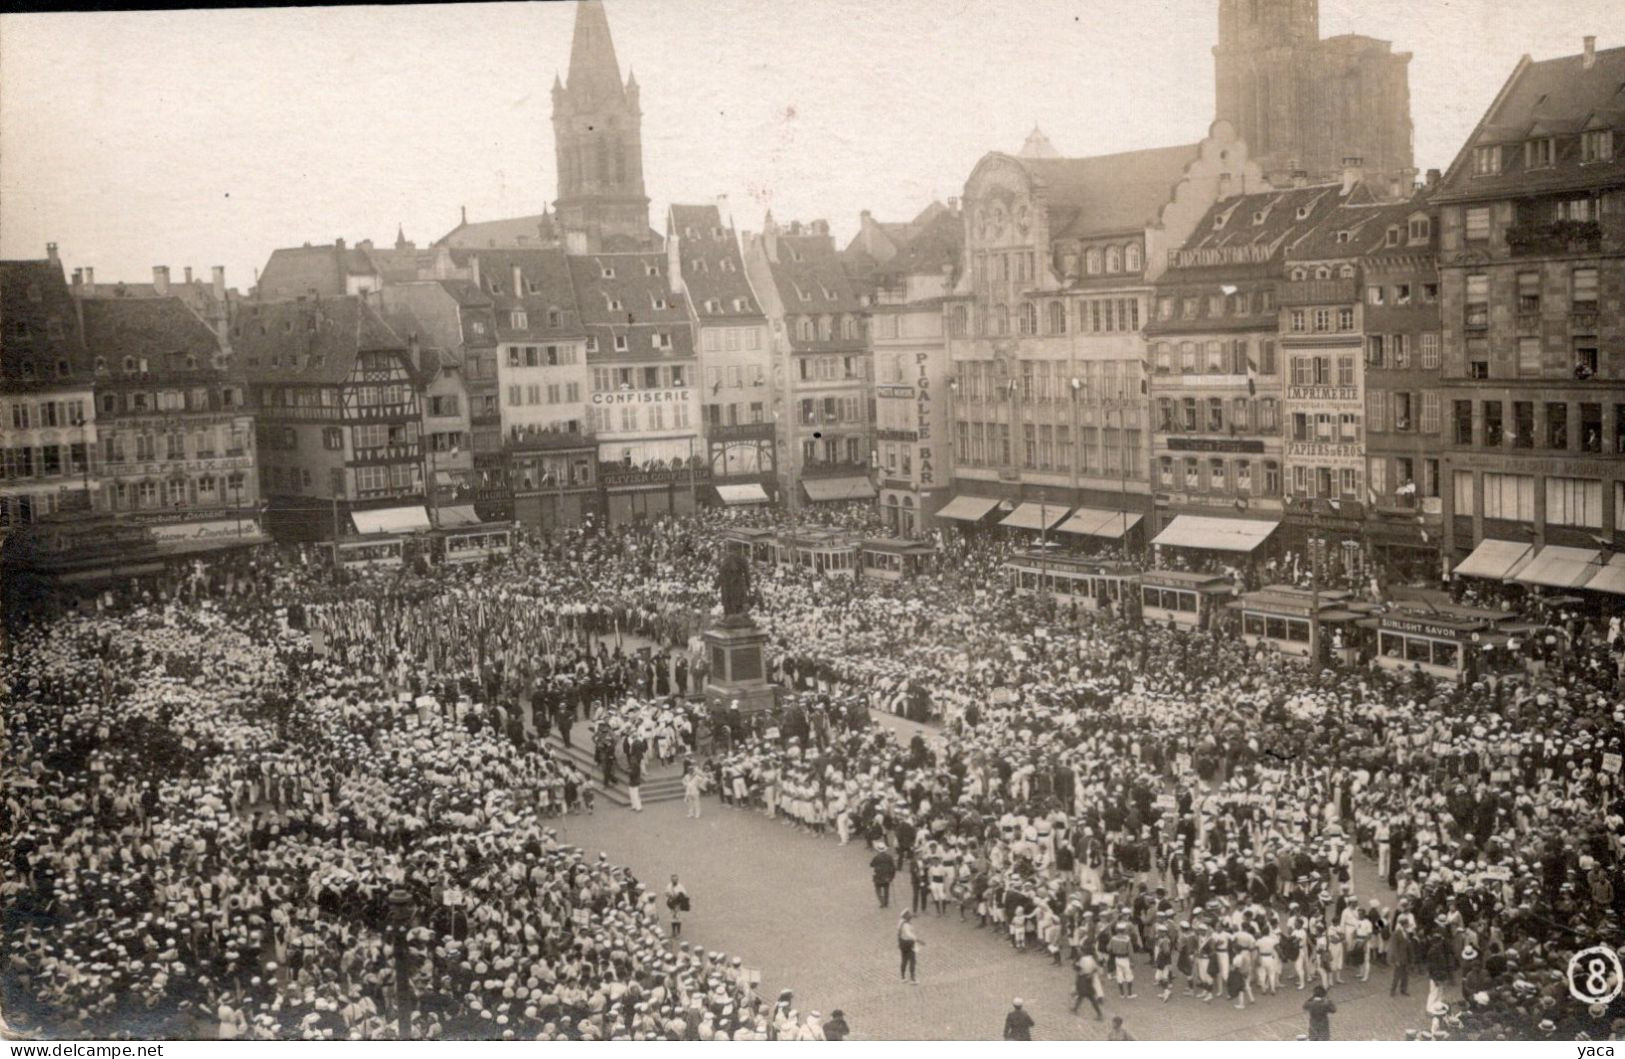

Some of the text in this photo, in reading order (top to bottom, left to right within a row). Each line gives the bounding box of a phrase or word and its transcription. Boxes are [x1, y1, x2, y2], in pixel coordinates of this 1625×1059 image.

[592, 391, 689, 404] CONFISERIE
[1288, 387, 1358, 400] IMPRIMERIE
[916, 353, 934, 484] PIGALLE BAR
[1288, 441, 1329, 456] PAPIERS
[1337, 444, 1362, 457] GROS
[1382, 618, 1456, 637] SUNLIGHT SAVON
